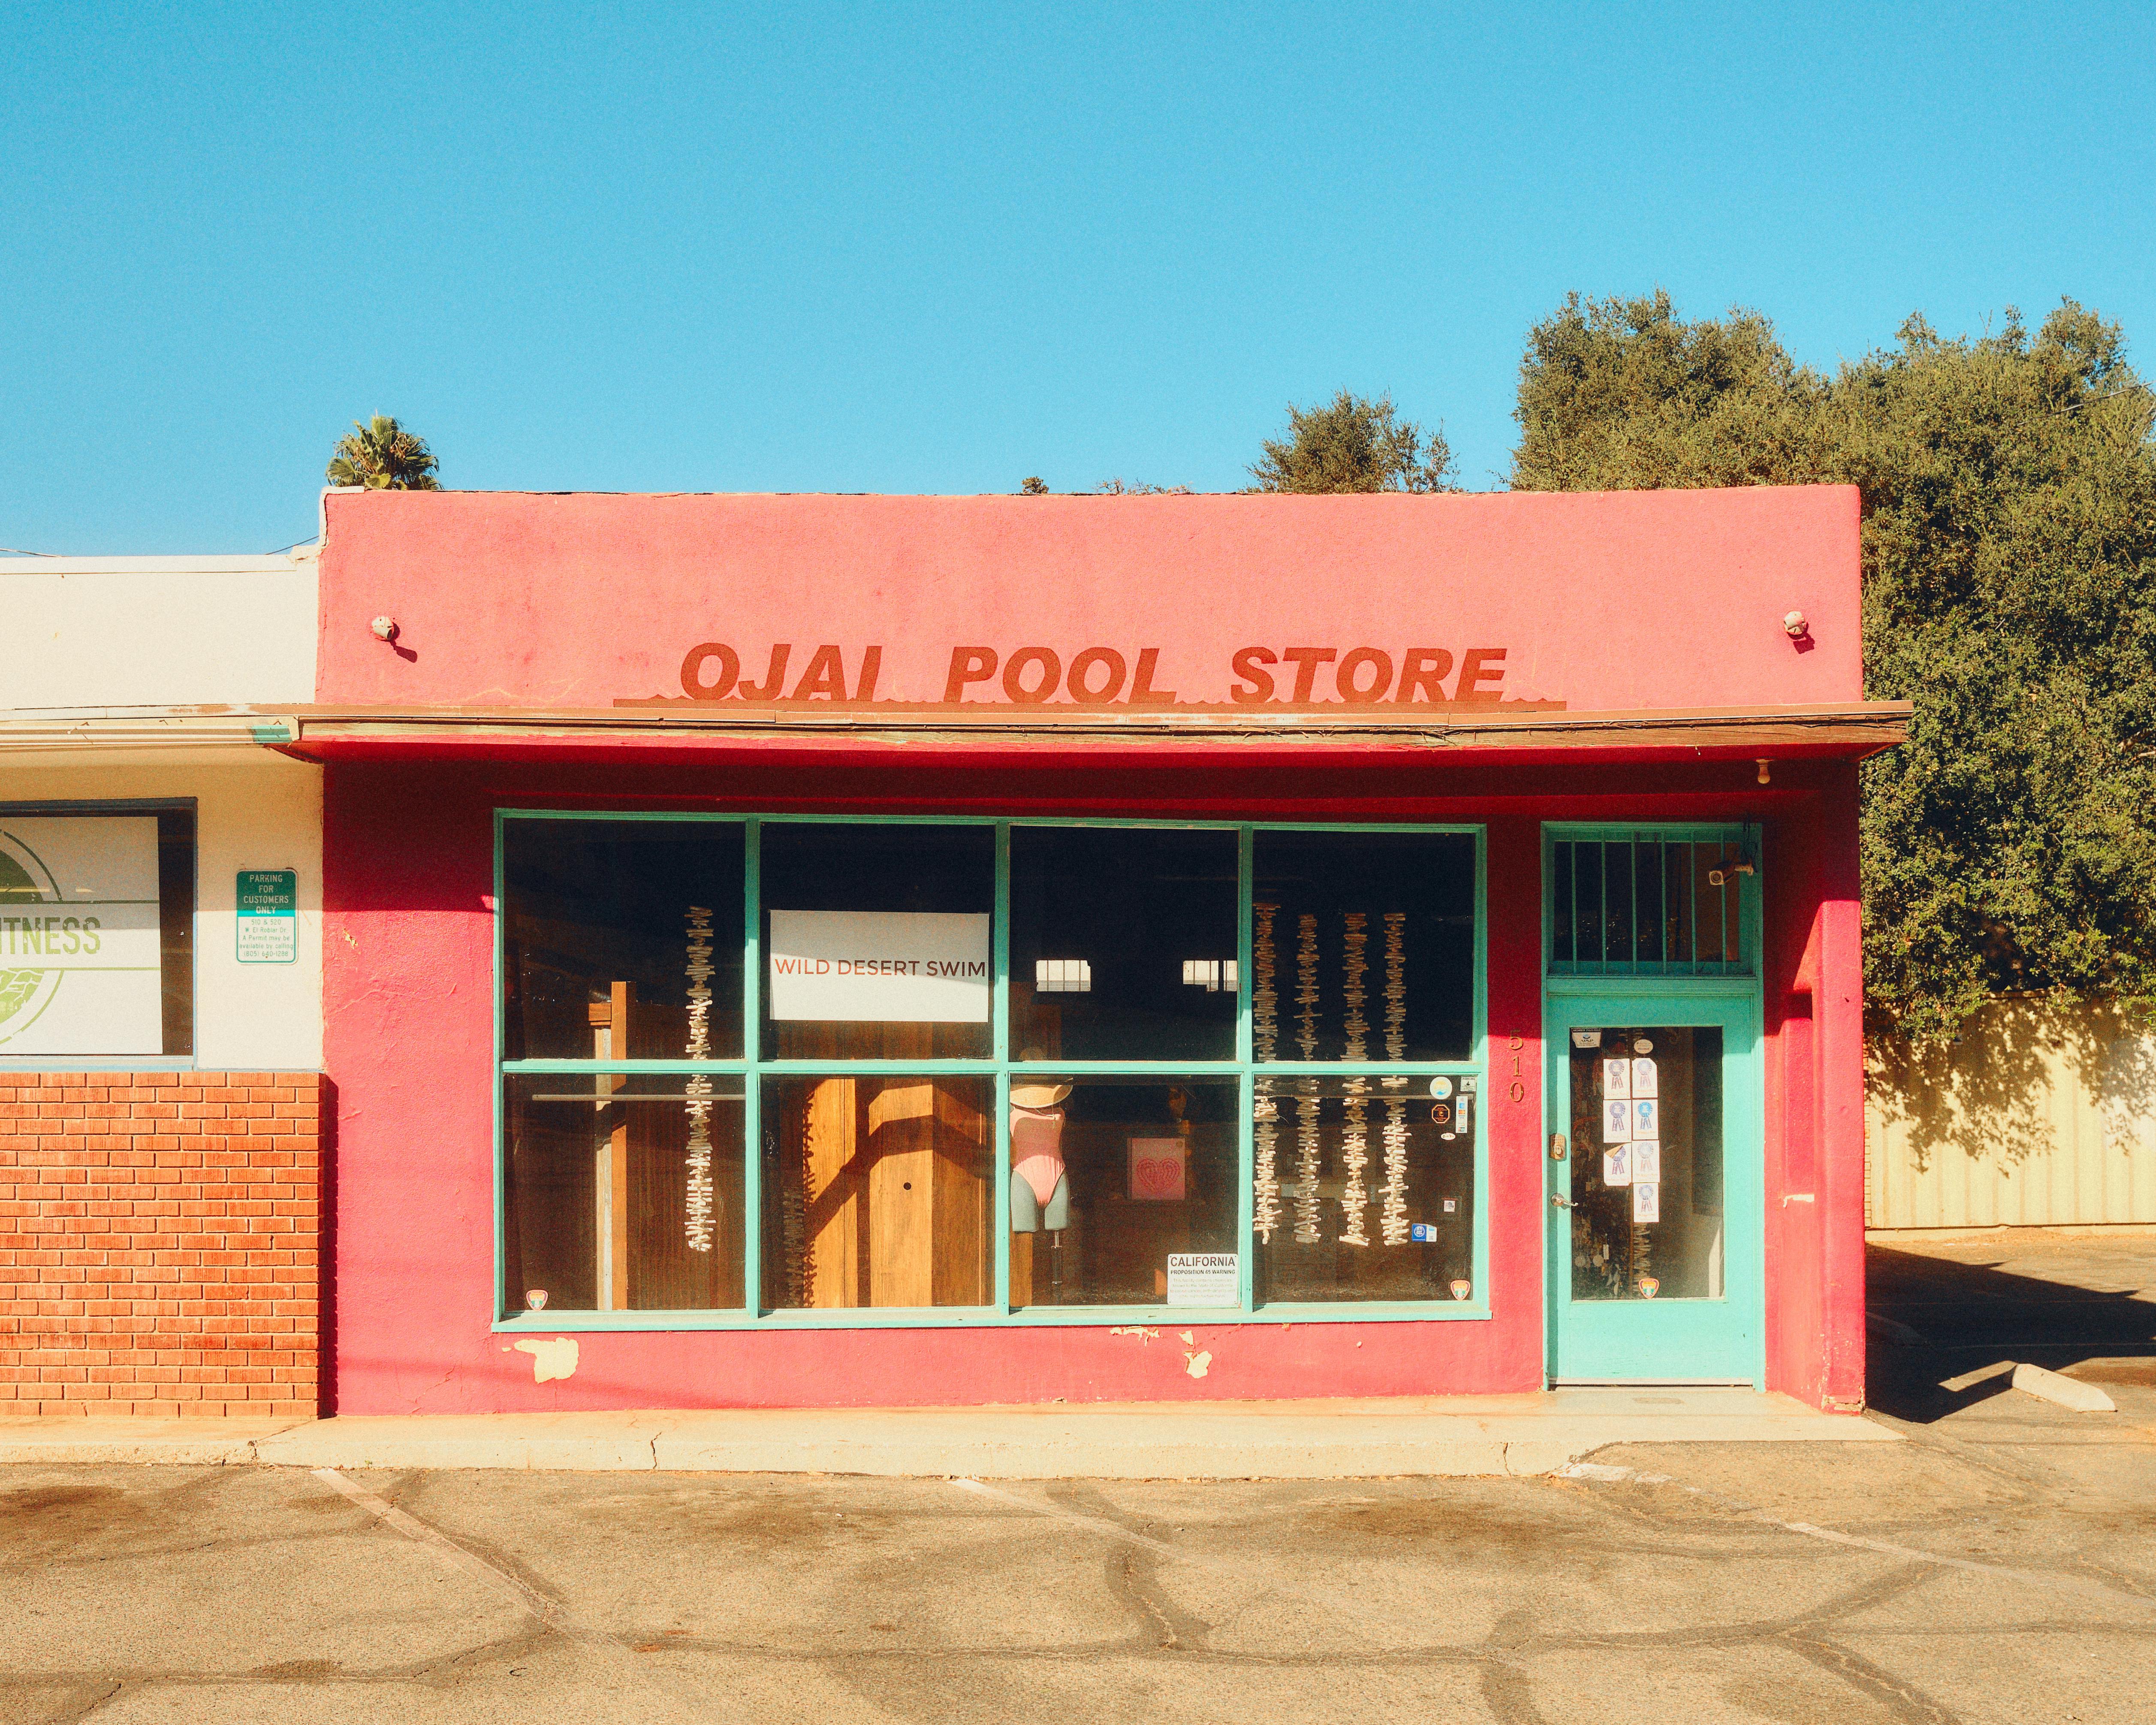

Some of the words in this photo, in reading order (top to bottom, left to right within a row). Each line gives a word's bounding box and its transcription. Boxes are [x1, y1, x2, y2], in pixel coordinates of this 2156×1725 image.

[681, 642, 882, 701] OJAI
[943, 646, 1177, 704] POOL
[1230, 646, 1508, 702] STORE
[250, 874, 283, 882] PARKING
[244, 895, 289, 903] CUSTOMERS
[256, 906, 276, 914] ONLY
[0, 917, 100, 954] TNESS
[775, 959, 830, 974] WILD
[838, 960, 920, 976] DESERT
[926, 961, 985, 976] SWIM
[1509, 1028, 1524, 1103] 510
[1170, 1257, 1235, 1266] CALIFORNIA
